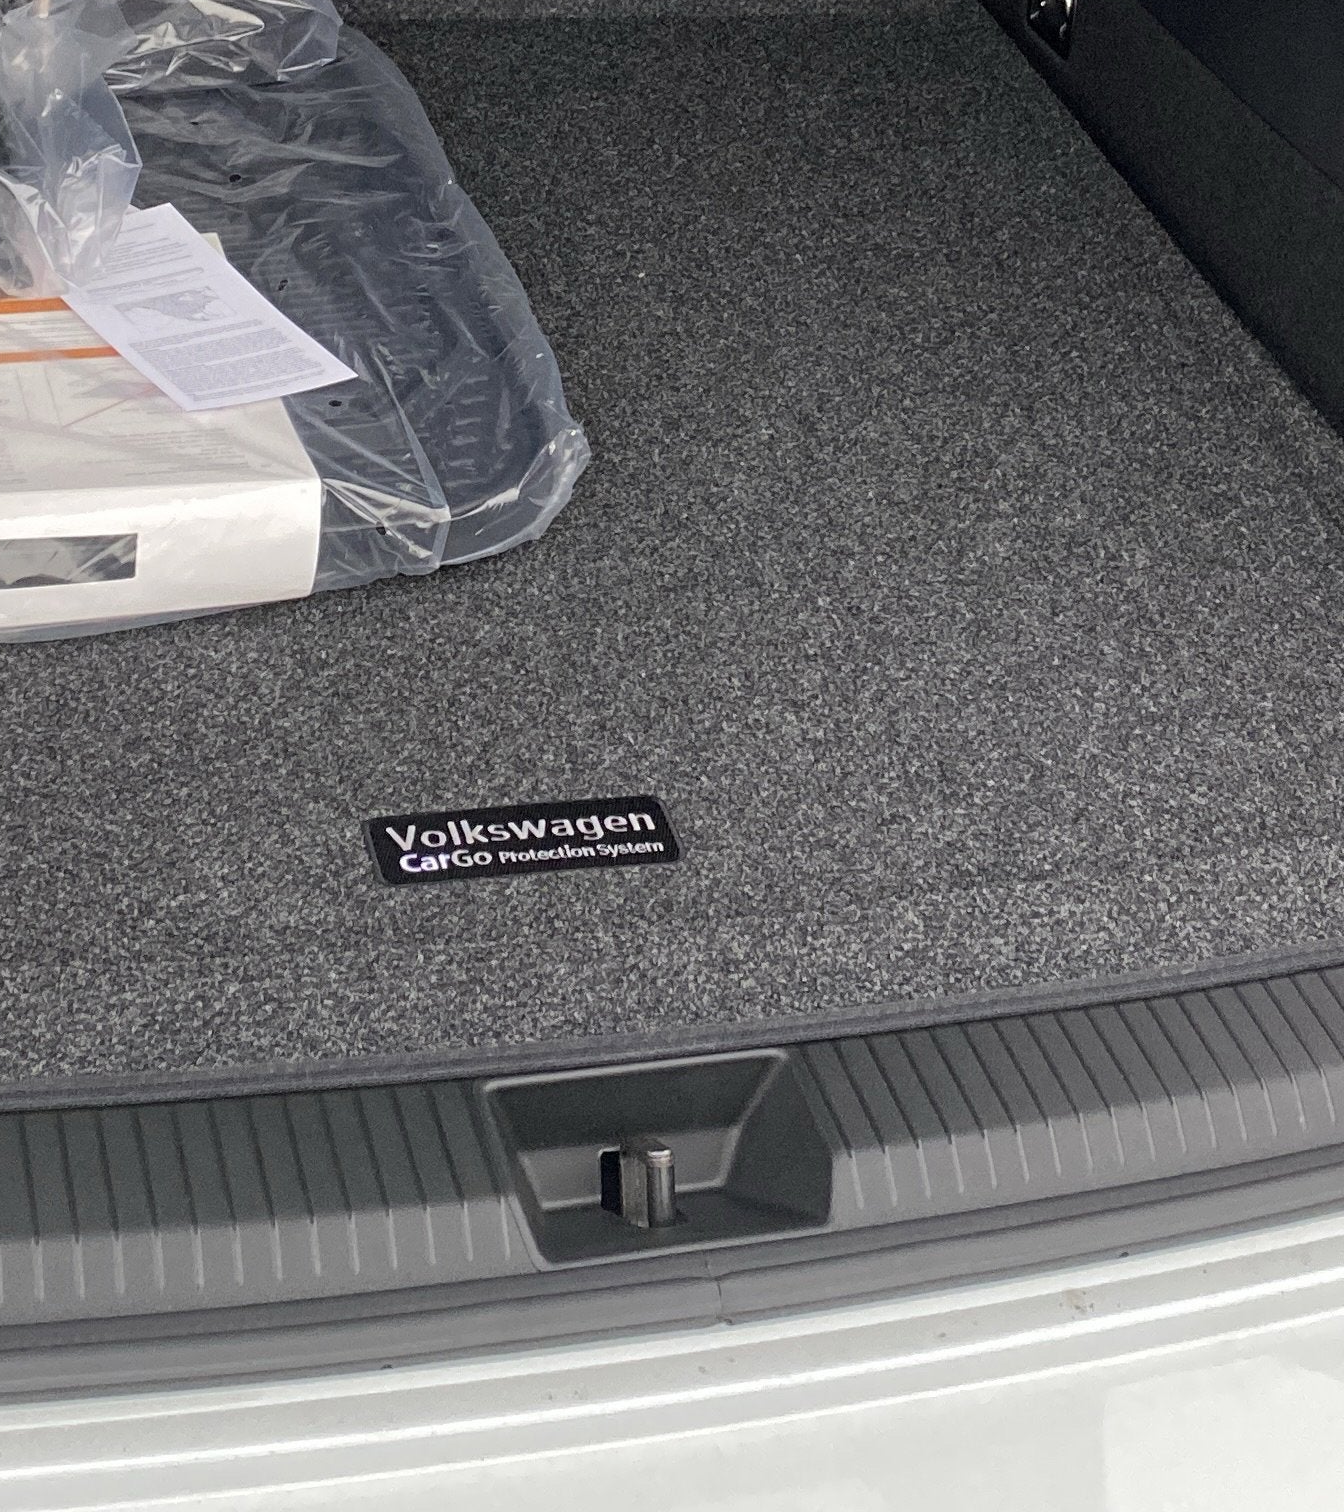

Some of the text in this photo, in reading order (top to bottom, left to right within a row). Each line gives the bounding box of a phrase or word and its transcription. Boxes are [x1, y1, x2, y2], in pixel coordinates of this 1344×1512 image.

[385, 811, 657, 852] Volkswagen
[498, 842, 596, 865] Protection
[596, 840, 665, 858] System
